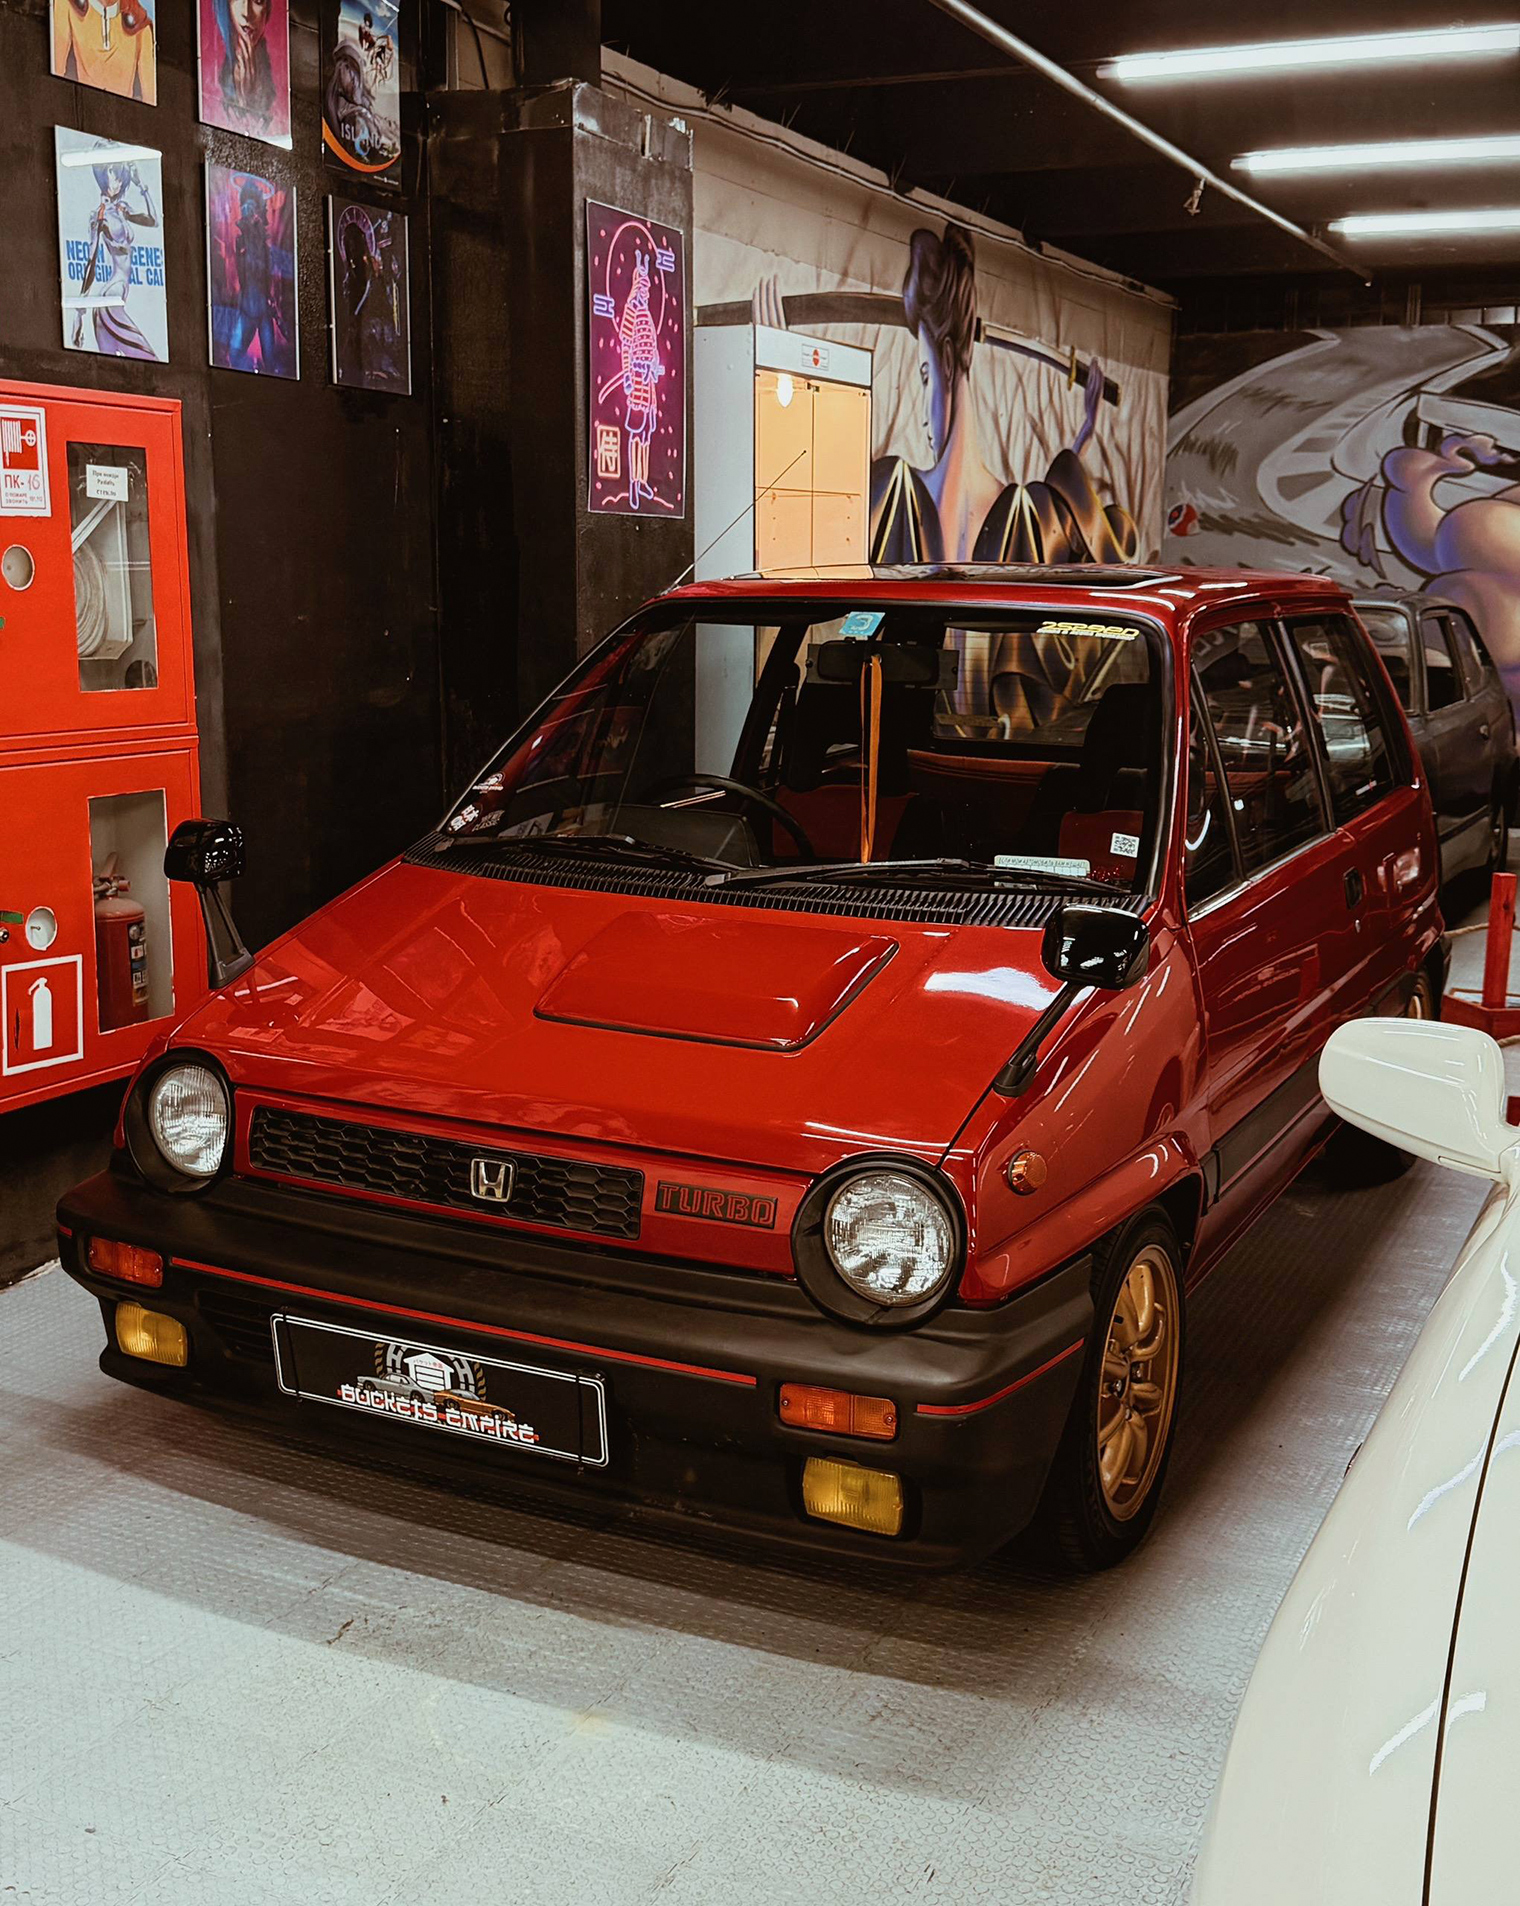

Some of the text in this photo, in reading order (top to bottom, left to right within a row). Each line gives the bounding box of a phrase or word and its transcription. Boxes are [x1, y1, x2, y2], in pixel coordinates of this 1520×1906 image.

[659, 1184, 775, 1224] TURBO
[339, 1384, 536, 1443] BUCKETS EMPIRE
